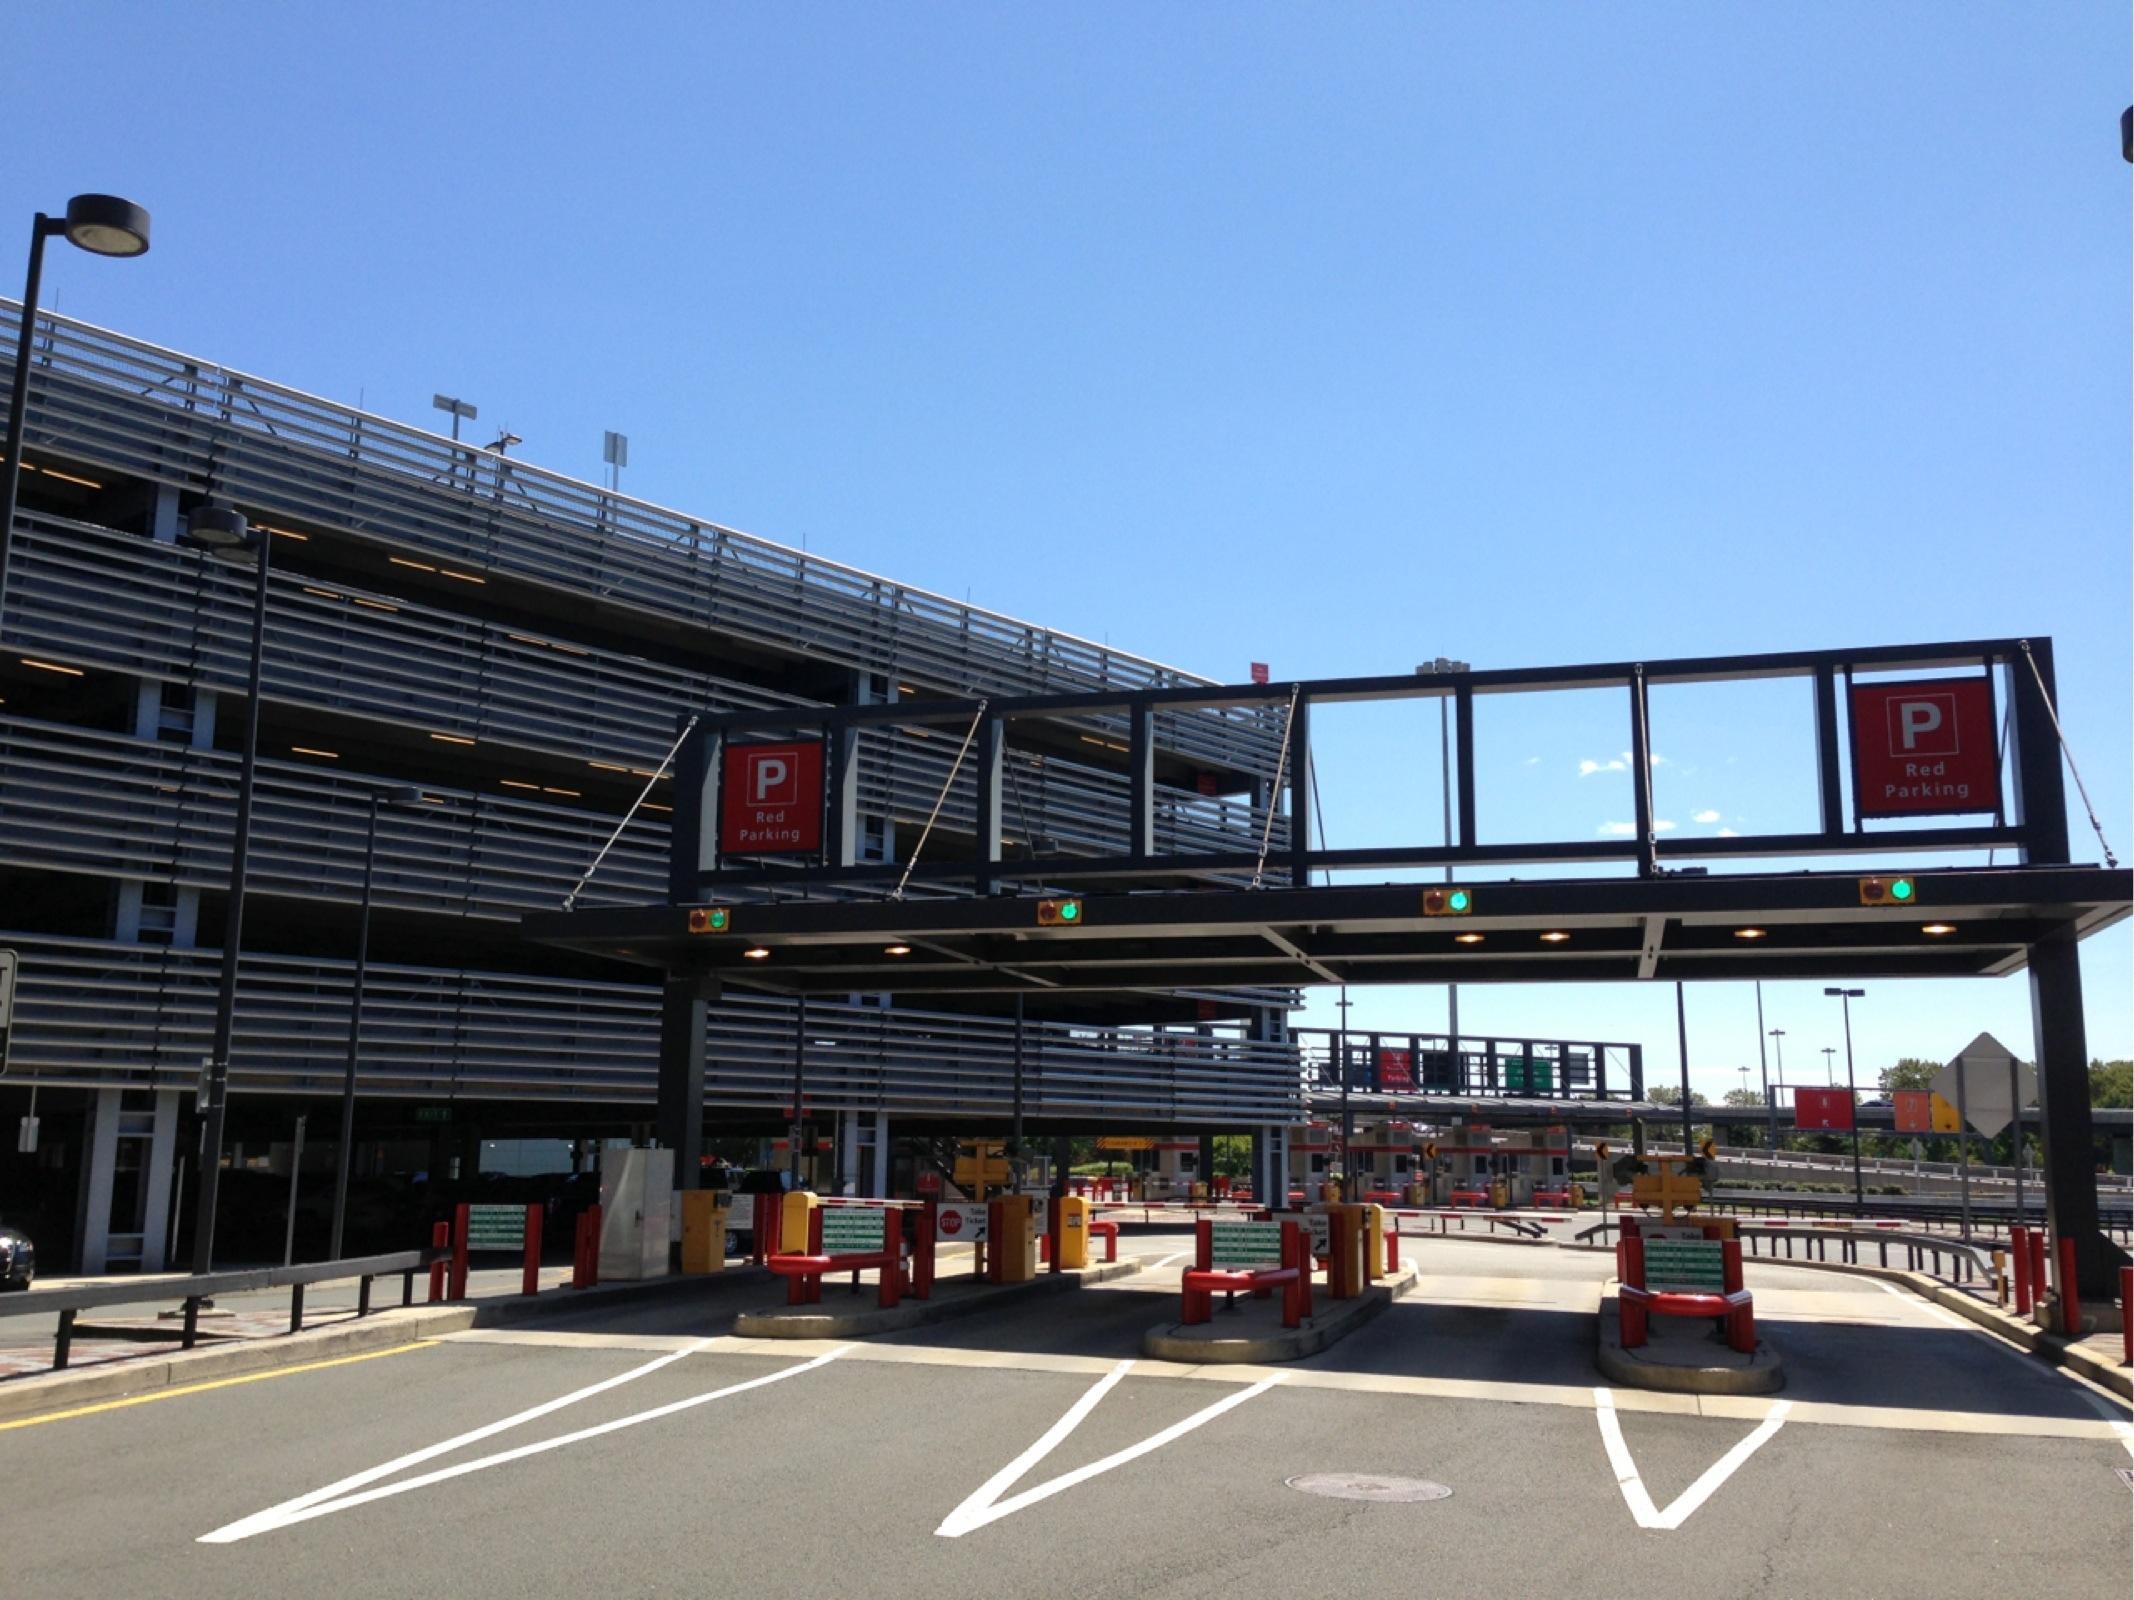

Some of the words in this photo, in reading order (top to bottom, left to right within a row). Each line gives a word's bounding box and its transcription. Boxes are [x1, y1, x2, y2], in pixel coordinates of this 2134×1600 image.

[1901, 702, 1942, 750] P
[1905, 761, 1946, 778] Red
[756, 759, 788, 801] P
[1884, 782, 1970, 800] Parking
[756, 811, 785, 824] Red
[739, 829, 801, 842] Parking
[941, 1217, 961, 1228] STOP
